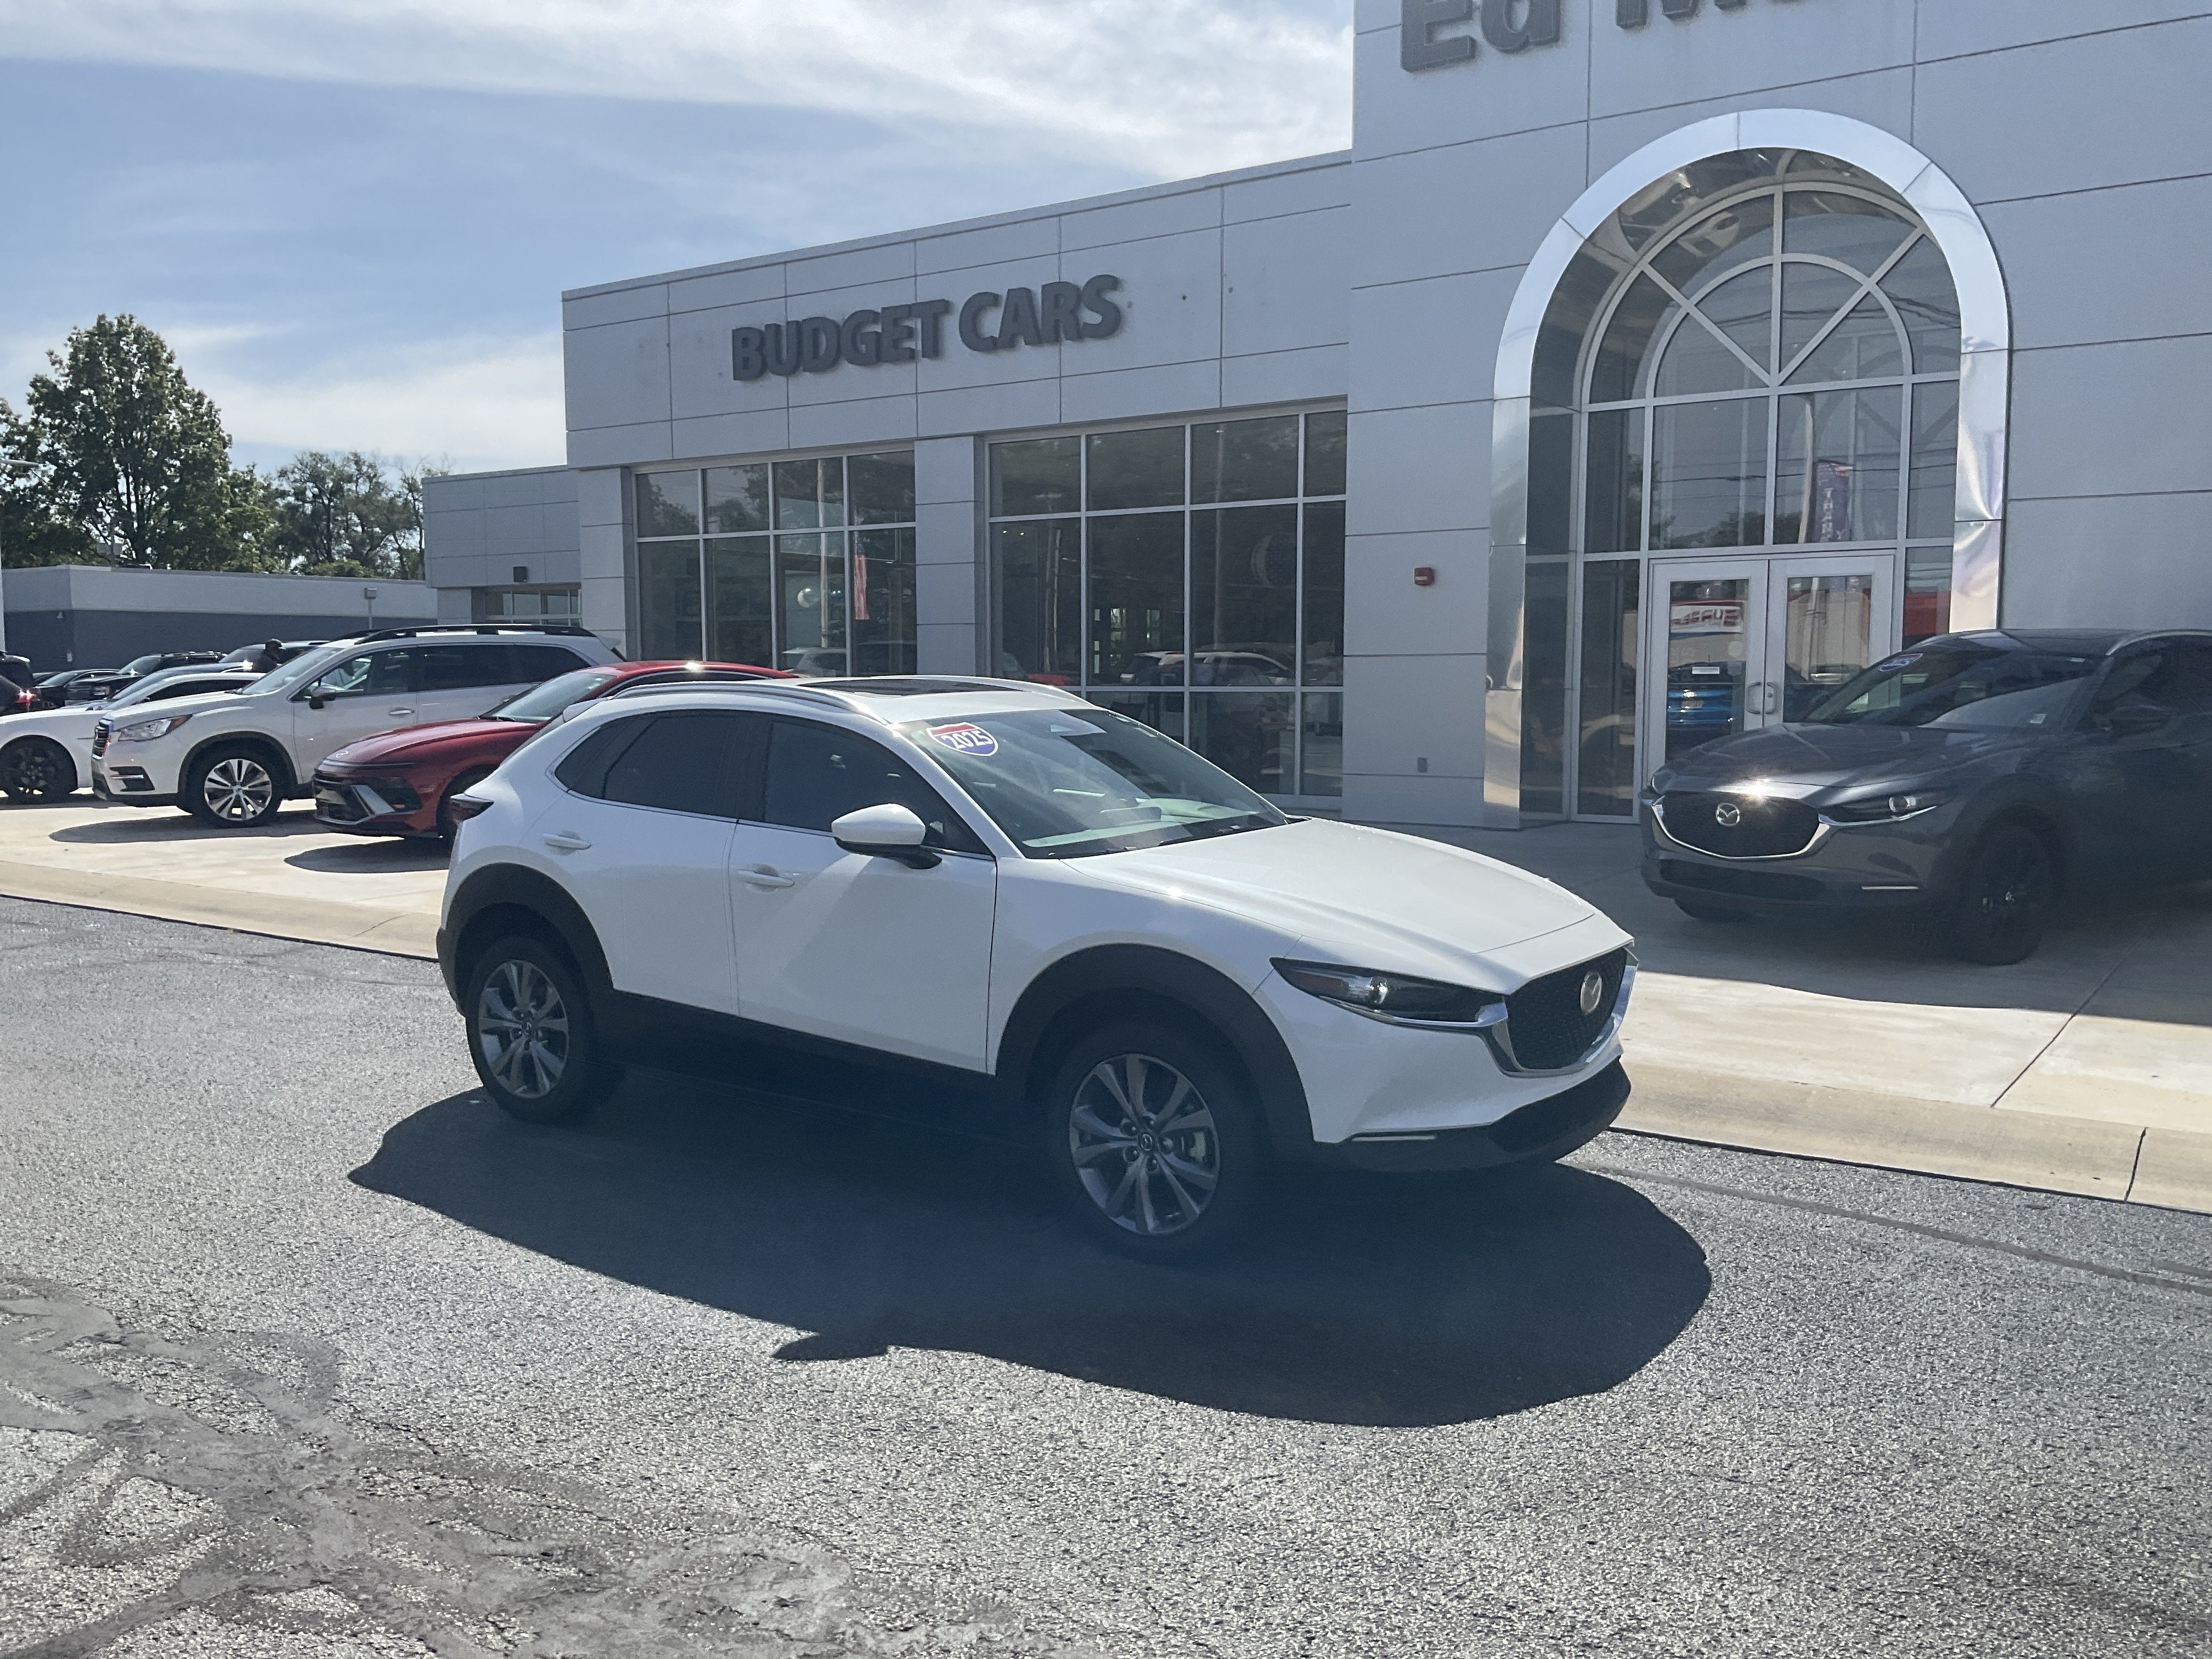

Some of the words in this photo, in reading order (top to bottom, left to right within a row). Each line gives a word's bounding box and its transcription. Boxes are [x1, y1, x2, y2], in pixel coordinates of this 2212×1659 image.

[732, 299, 951, 381] BUDGET
[959, 274, 1122, 352] CARS
[941, 730, 994, 749] 2025
